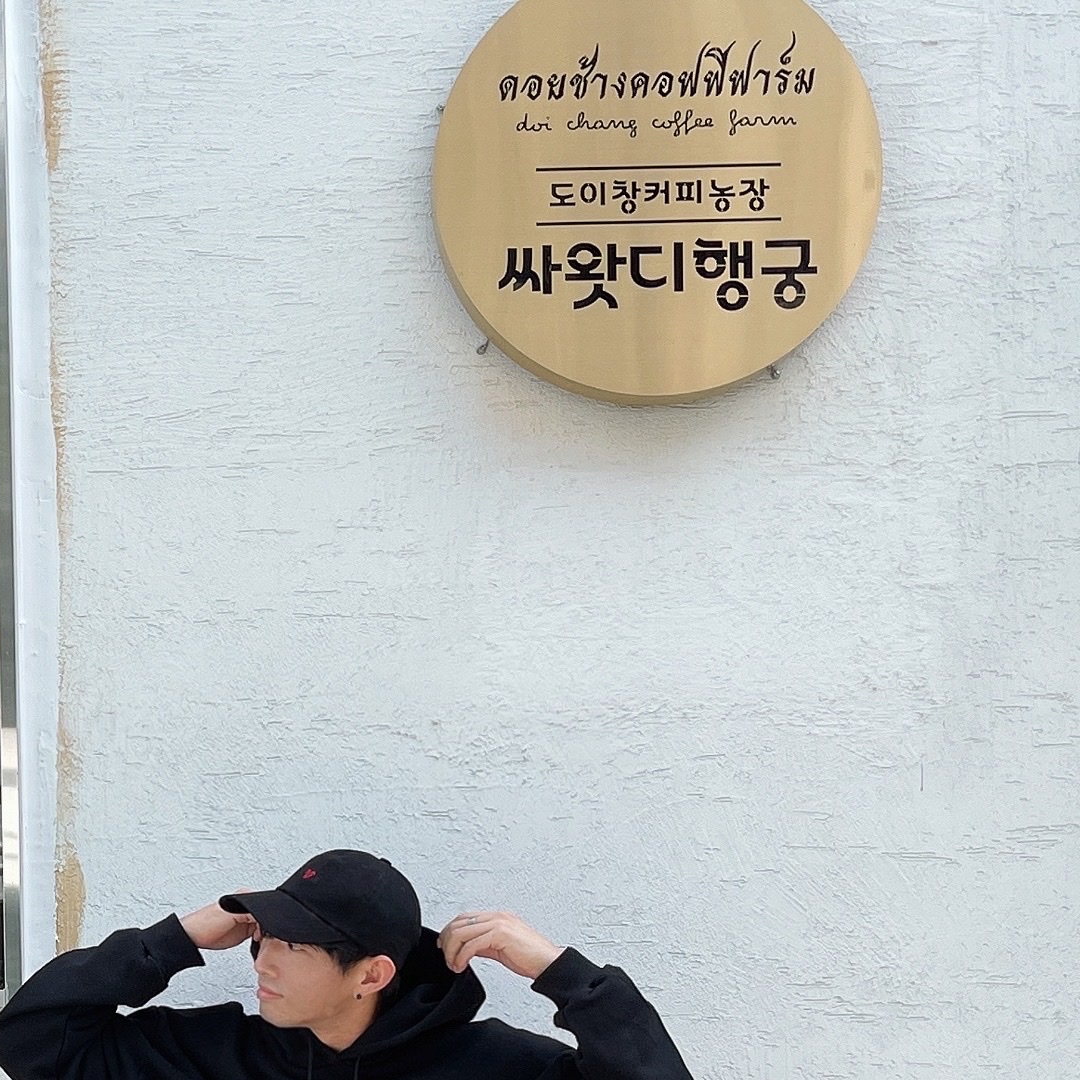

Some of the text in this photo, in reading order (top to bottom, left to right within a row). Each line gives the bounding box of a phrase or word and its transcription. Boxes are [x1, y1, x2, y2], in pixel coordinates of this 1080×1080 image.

[516, 108, 797, 138] doi chang coffee farm
[549, 178, 770, 215] 도이창커피농장
[498, 237, 818, 312] 싸왓디행궁
